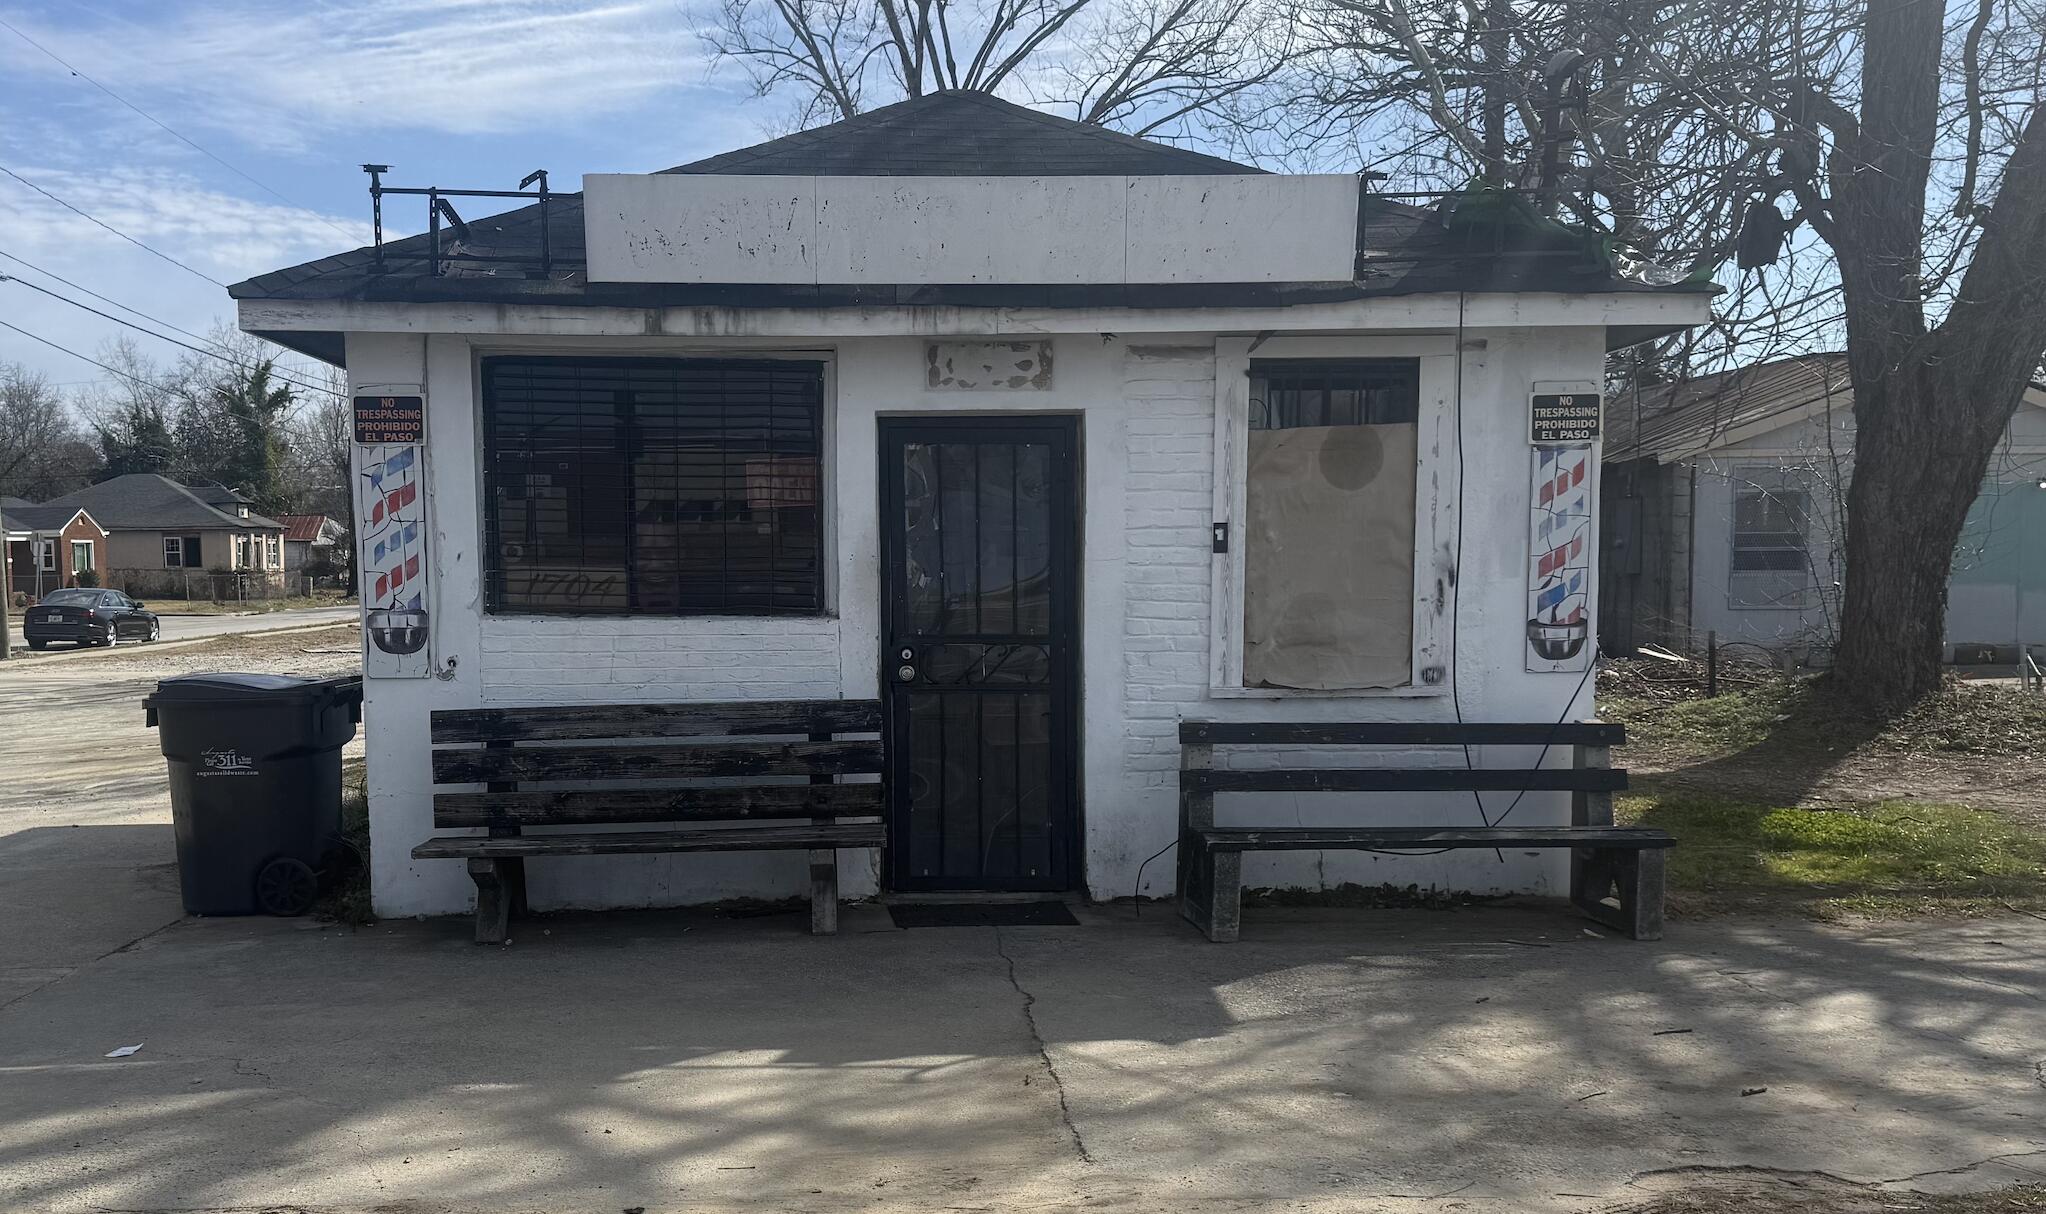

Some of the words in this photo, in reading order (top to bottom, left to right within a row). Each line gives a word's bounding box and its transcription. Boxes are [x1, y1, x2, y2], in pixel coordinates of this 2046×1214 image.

[381, 398, 395, 407] NO
[1559, 396, 1573, 405] NO
[356, 409, 421, 419] TRESPASSING
[1534, 407, 1598, 417] TRESPASSING
[357, 422, 420, 431] PROHIBIDO
[1534, 420, 1597, 429] PROHIBIDO
[364, 433, 379, 441] EL
[383, 433, 414, 441] PASO
[1541, 431, 1556, 439] EL
[1559, 430, 1589, 439] PASO
[753, 476, 813, 501] OPEN
[526, 573, 617, 605] 1704
[217, 754, 237, 766] 311
